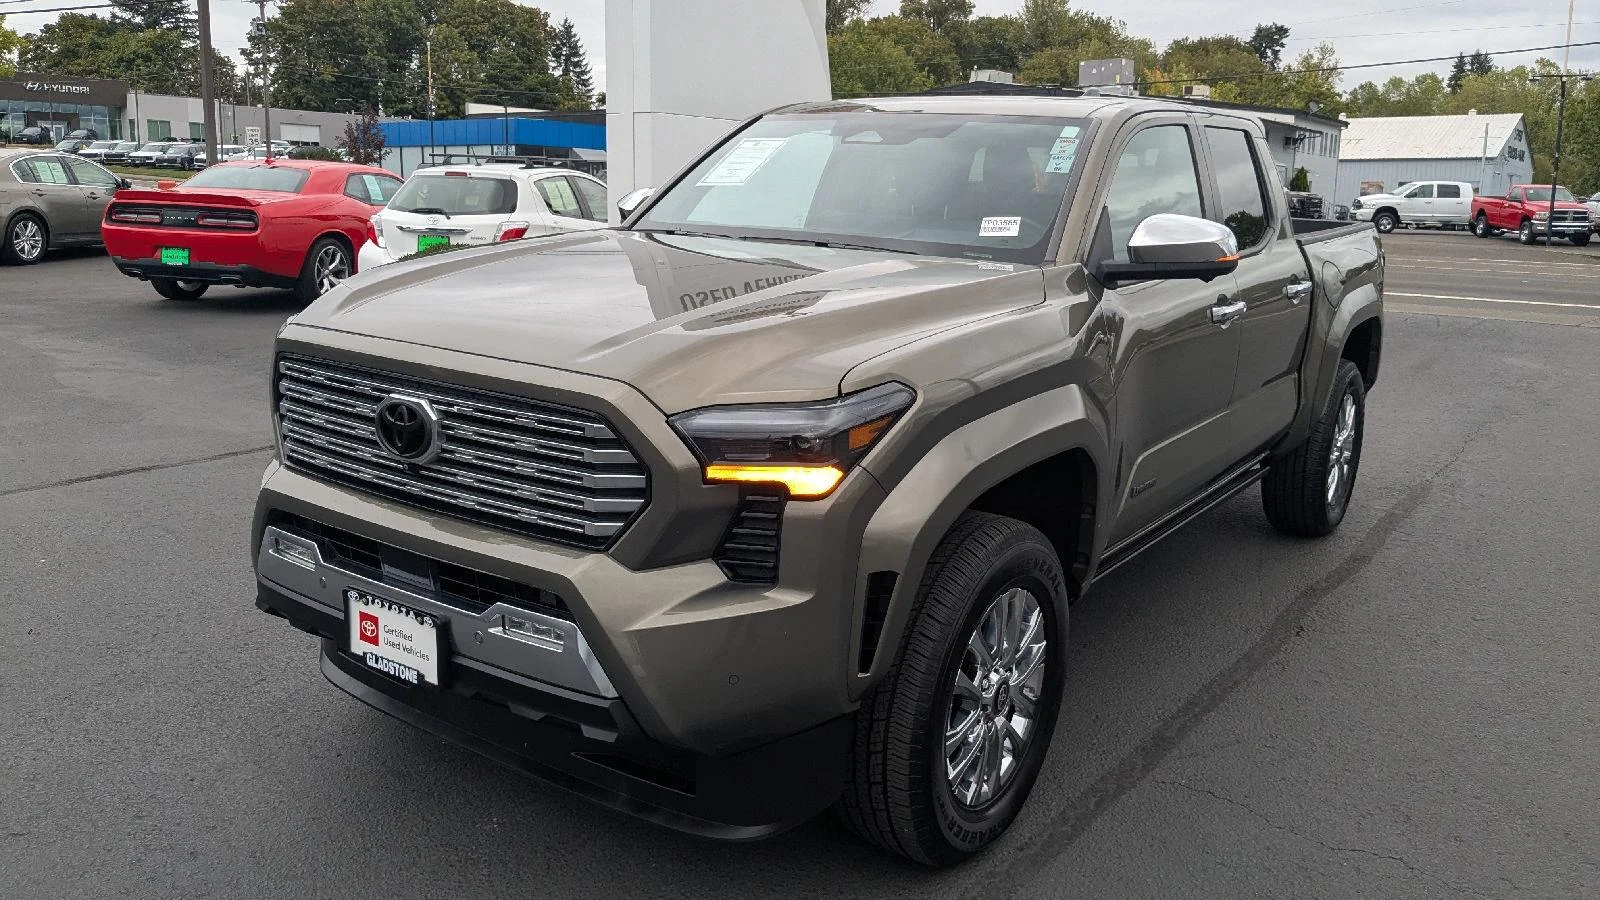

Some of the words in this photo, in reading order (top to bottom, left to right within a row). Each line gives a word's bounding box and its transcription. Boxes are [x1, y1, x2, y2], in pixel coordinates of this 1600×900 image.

[44, 83, 90, 95] HYUNDAI
[366, 596, 416, 620] TOYOTA
[383, 624, 413, 643] Certified
[383, 636, 401, 651] Used
[401, 642, 430, 662] Vehicles
[366, 653, 418, 684] GLADSTONE
